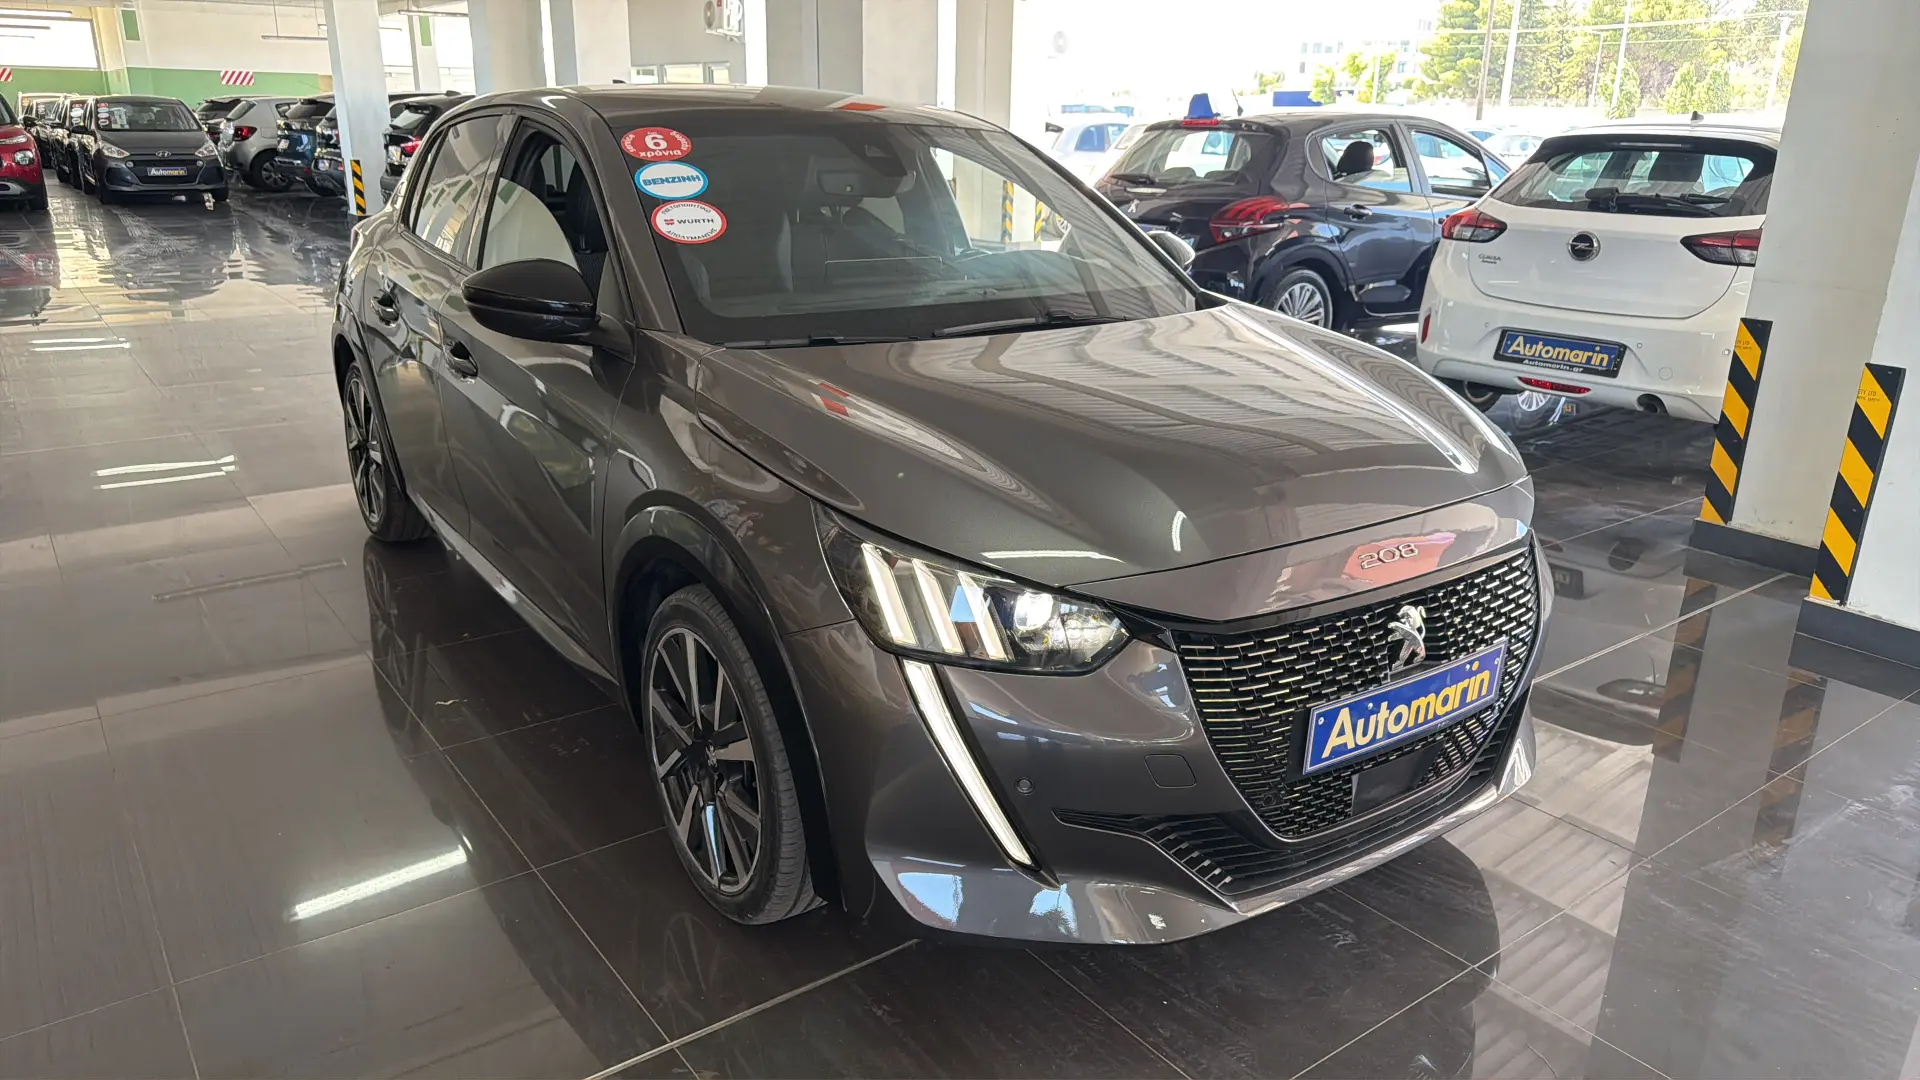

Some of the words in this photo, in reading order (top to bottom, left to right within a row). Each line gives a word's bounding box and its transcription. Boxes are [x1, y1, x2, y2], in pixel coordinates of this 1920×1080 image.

[645, 134, 667, 149] 6
[639, 149, 682, 158] χρόνια
[1507, 336, 1609, 367] Automarin
[1523, 359, 1584, 373] Automarin.gr
[1358, 543, 1419, 570] 208
[1321, 661, 1491, 758] Automarin
